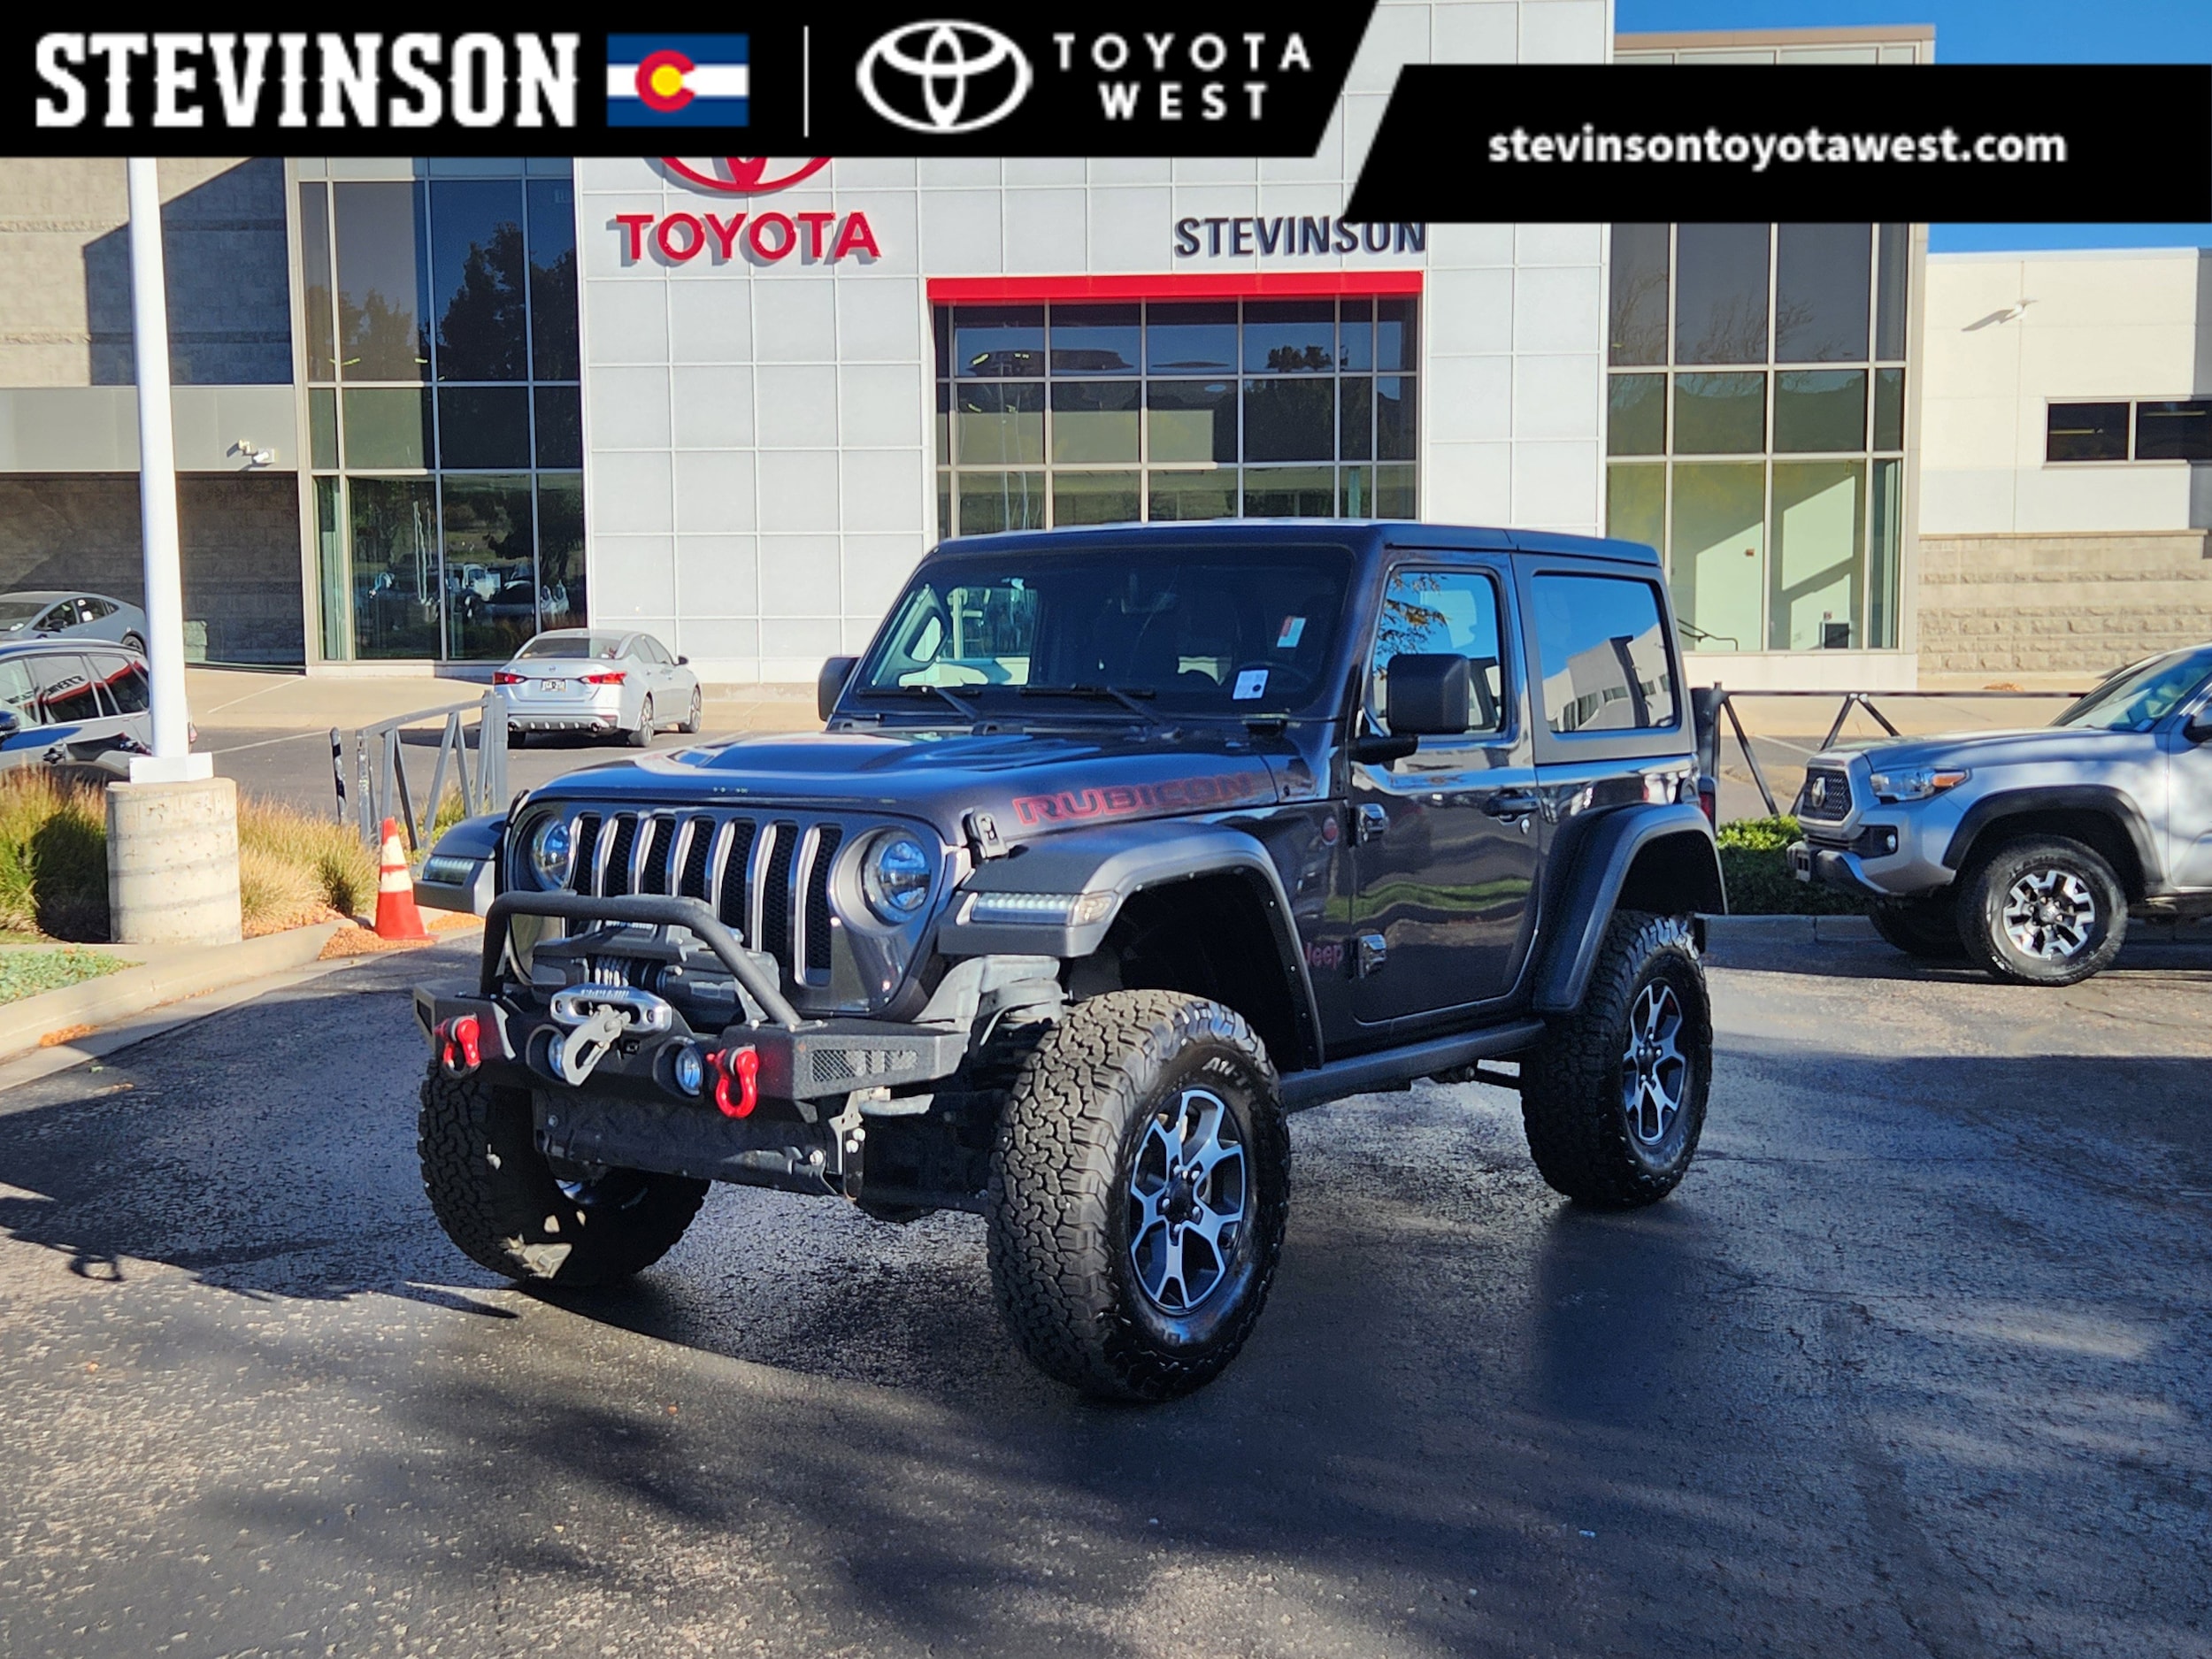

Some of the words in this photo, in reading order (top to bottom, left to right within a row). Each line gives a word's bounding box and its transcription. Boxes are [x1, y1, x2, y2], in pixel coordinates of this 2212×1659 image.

[616, 211, 882, 260] TOYOTA
[1174, 215, 1426, 256] STEVINSON
[1012, 772, 1253, 826] RUBICON
